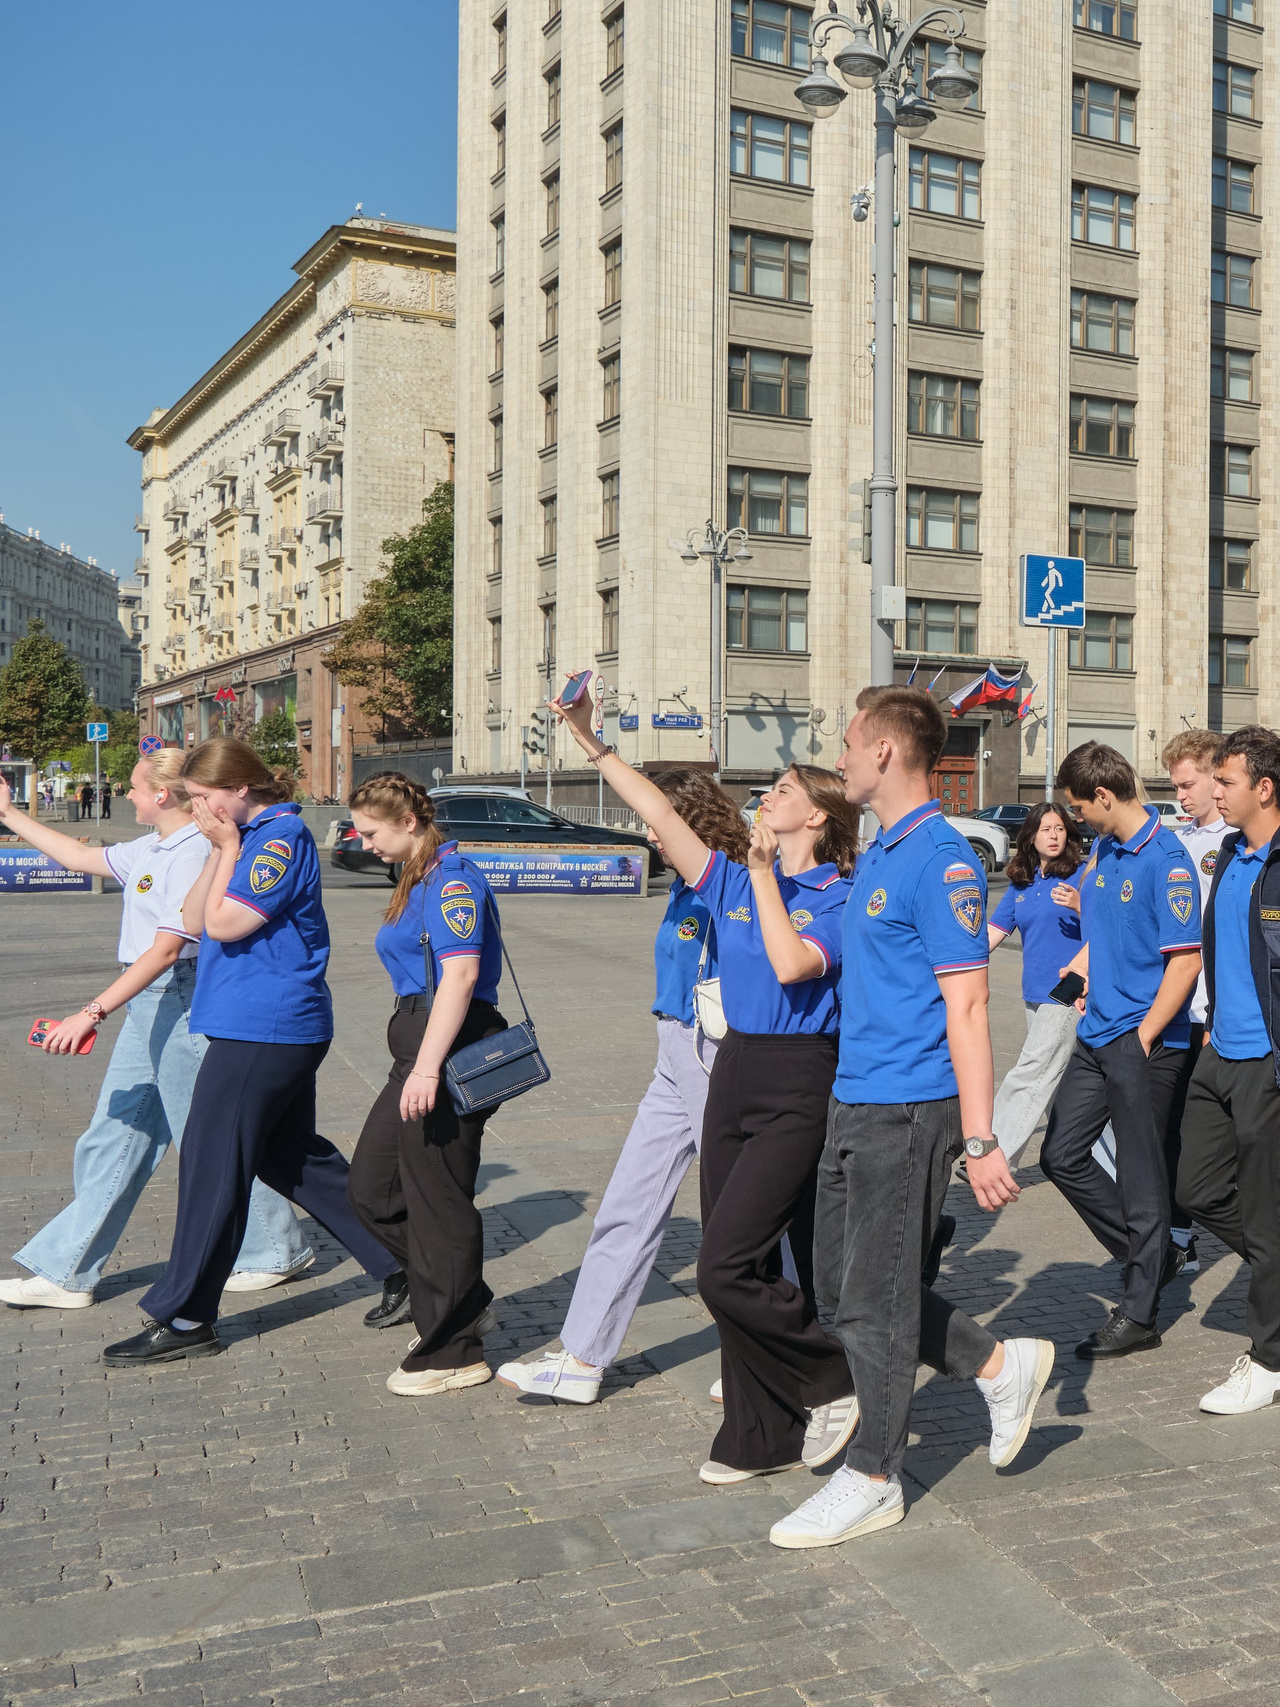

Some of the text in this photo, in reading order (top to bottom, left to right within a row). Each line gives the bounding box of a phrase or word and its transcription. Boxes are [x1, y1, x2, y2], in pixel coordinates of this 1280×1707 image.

[9, 858, 14, 866] В
[16, 857, 49, 866] МОСКВЕ
[495, 861, 524, 870] СЛУЖБА
[526, 862, 535, 870] ПО
[536, 862, 574, 871] КОНТРАКТУ
[575, 863, 580, 871] В
[581, 863, 608, 871] МОСКВЕ
